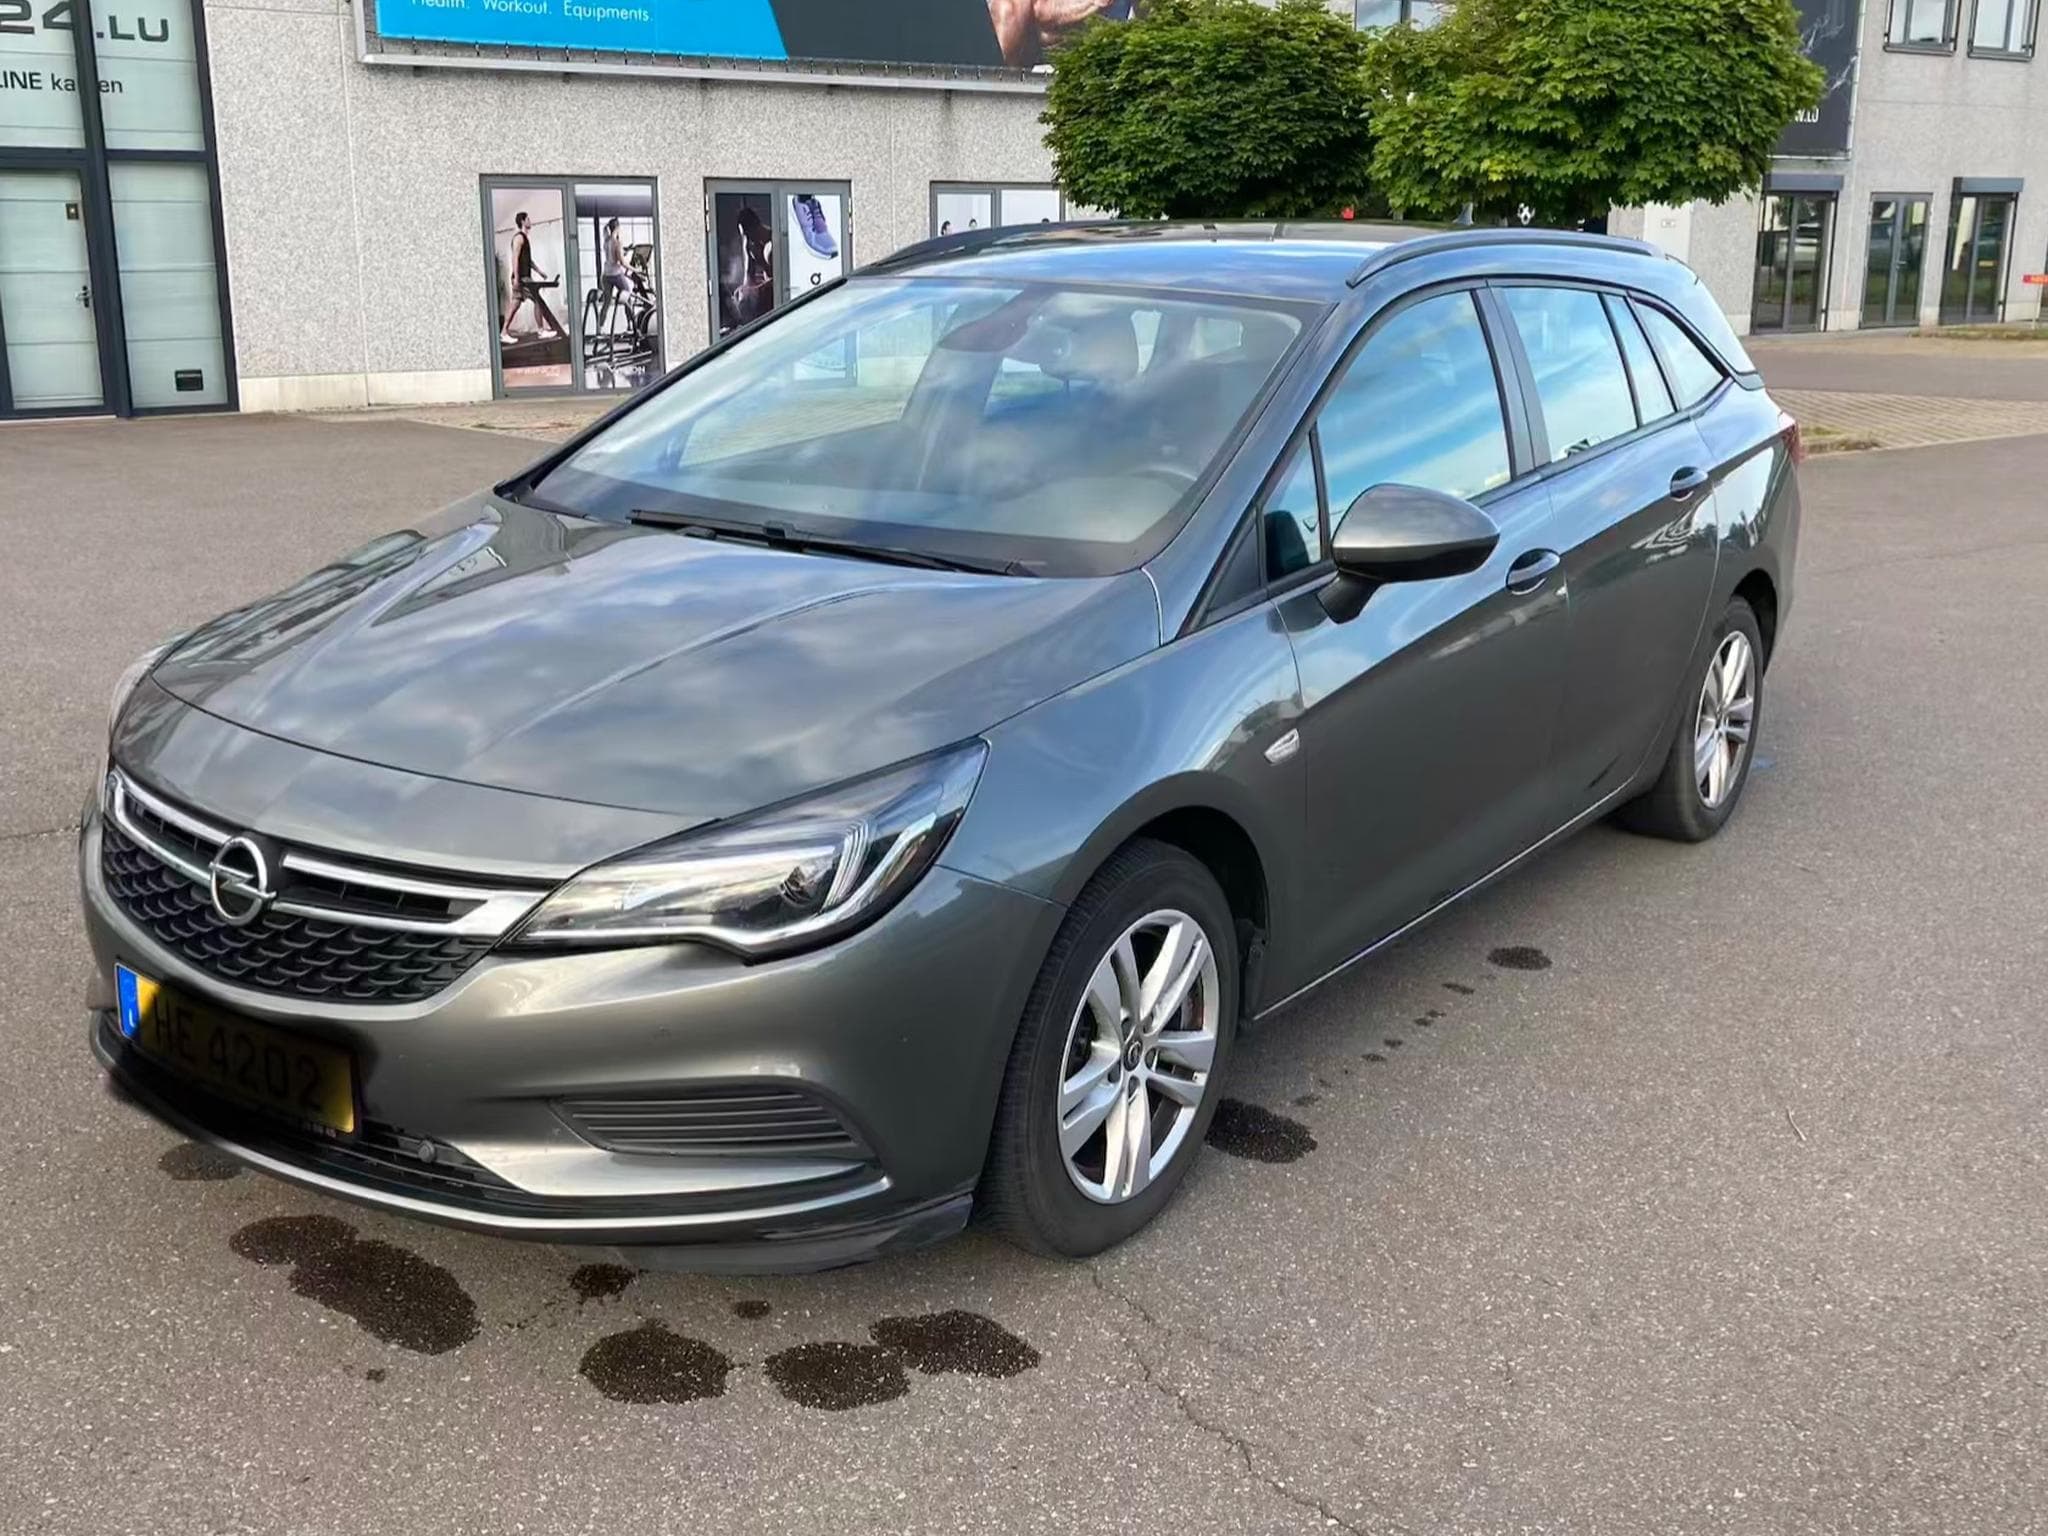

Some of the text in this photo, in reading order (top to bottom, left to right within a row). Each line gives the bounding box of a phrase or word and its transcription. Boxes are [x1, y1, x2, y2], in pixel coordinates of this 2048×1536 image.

[482, 0, 552, 14] Workout.
[563, 0, 654, 21] Equipments.
[0, 71, 123, 93] INE kaen
[152, 995, 322, 1110] HE 4202
